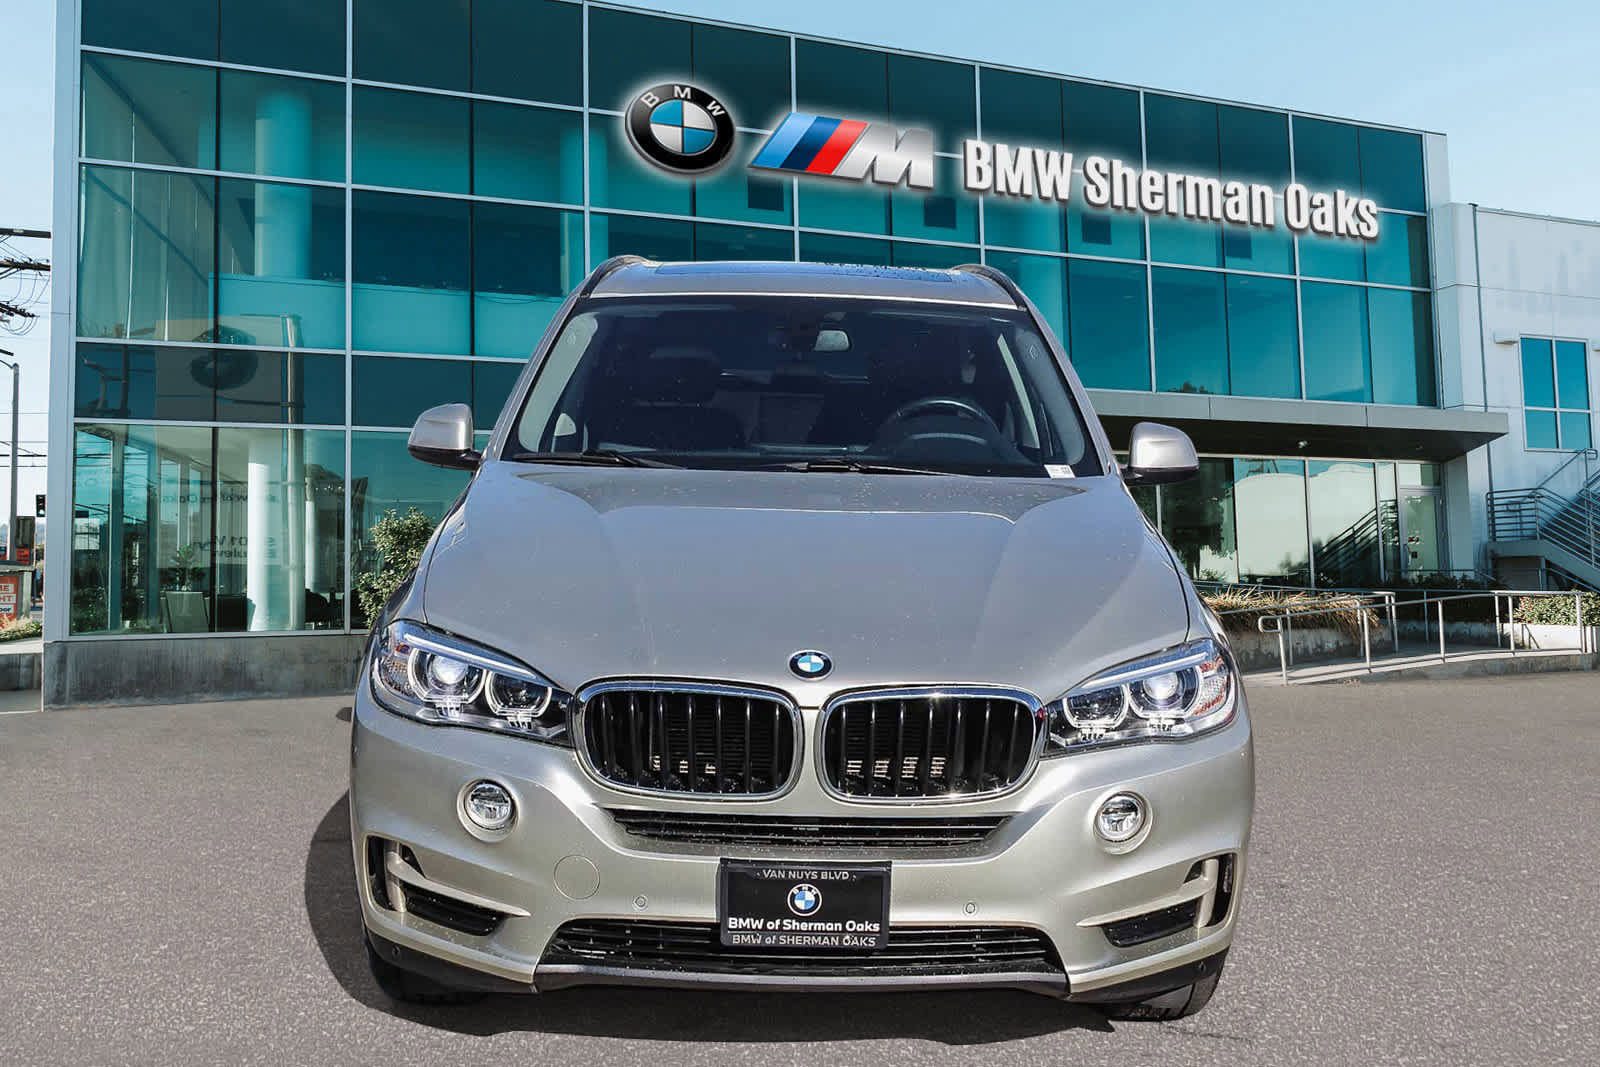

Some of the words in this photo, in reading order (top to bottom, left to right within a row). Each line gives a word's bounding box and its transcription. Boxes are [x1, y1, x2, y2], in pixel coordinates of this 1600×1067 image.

[641, 84, 725, 118] BMW
[963, 138, 1073, 202] BMW
[1083, 156, 1275, 228] Sherman
[1284, 182, 1380, 241] Oaks
[762, 869, 786, 879] VAN
[788, 870, 818, 880] NUYS
[821, 871, 850, 880] BLVD
[728, 917, 764, 930] BMW
[766, 919, 781, 930] of
[782, 919, 842, 931] Sherman
[845, 920, 880, 932] Oaks
[732, 934, 762, 944] BMW
[765, 935, 776, 945] of
[778, 935, 839, 946] SHERMAN
[842, 935, 876, 947] OAKS
